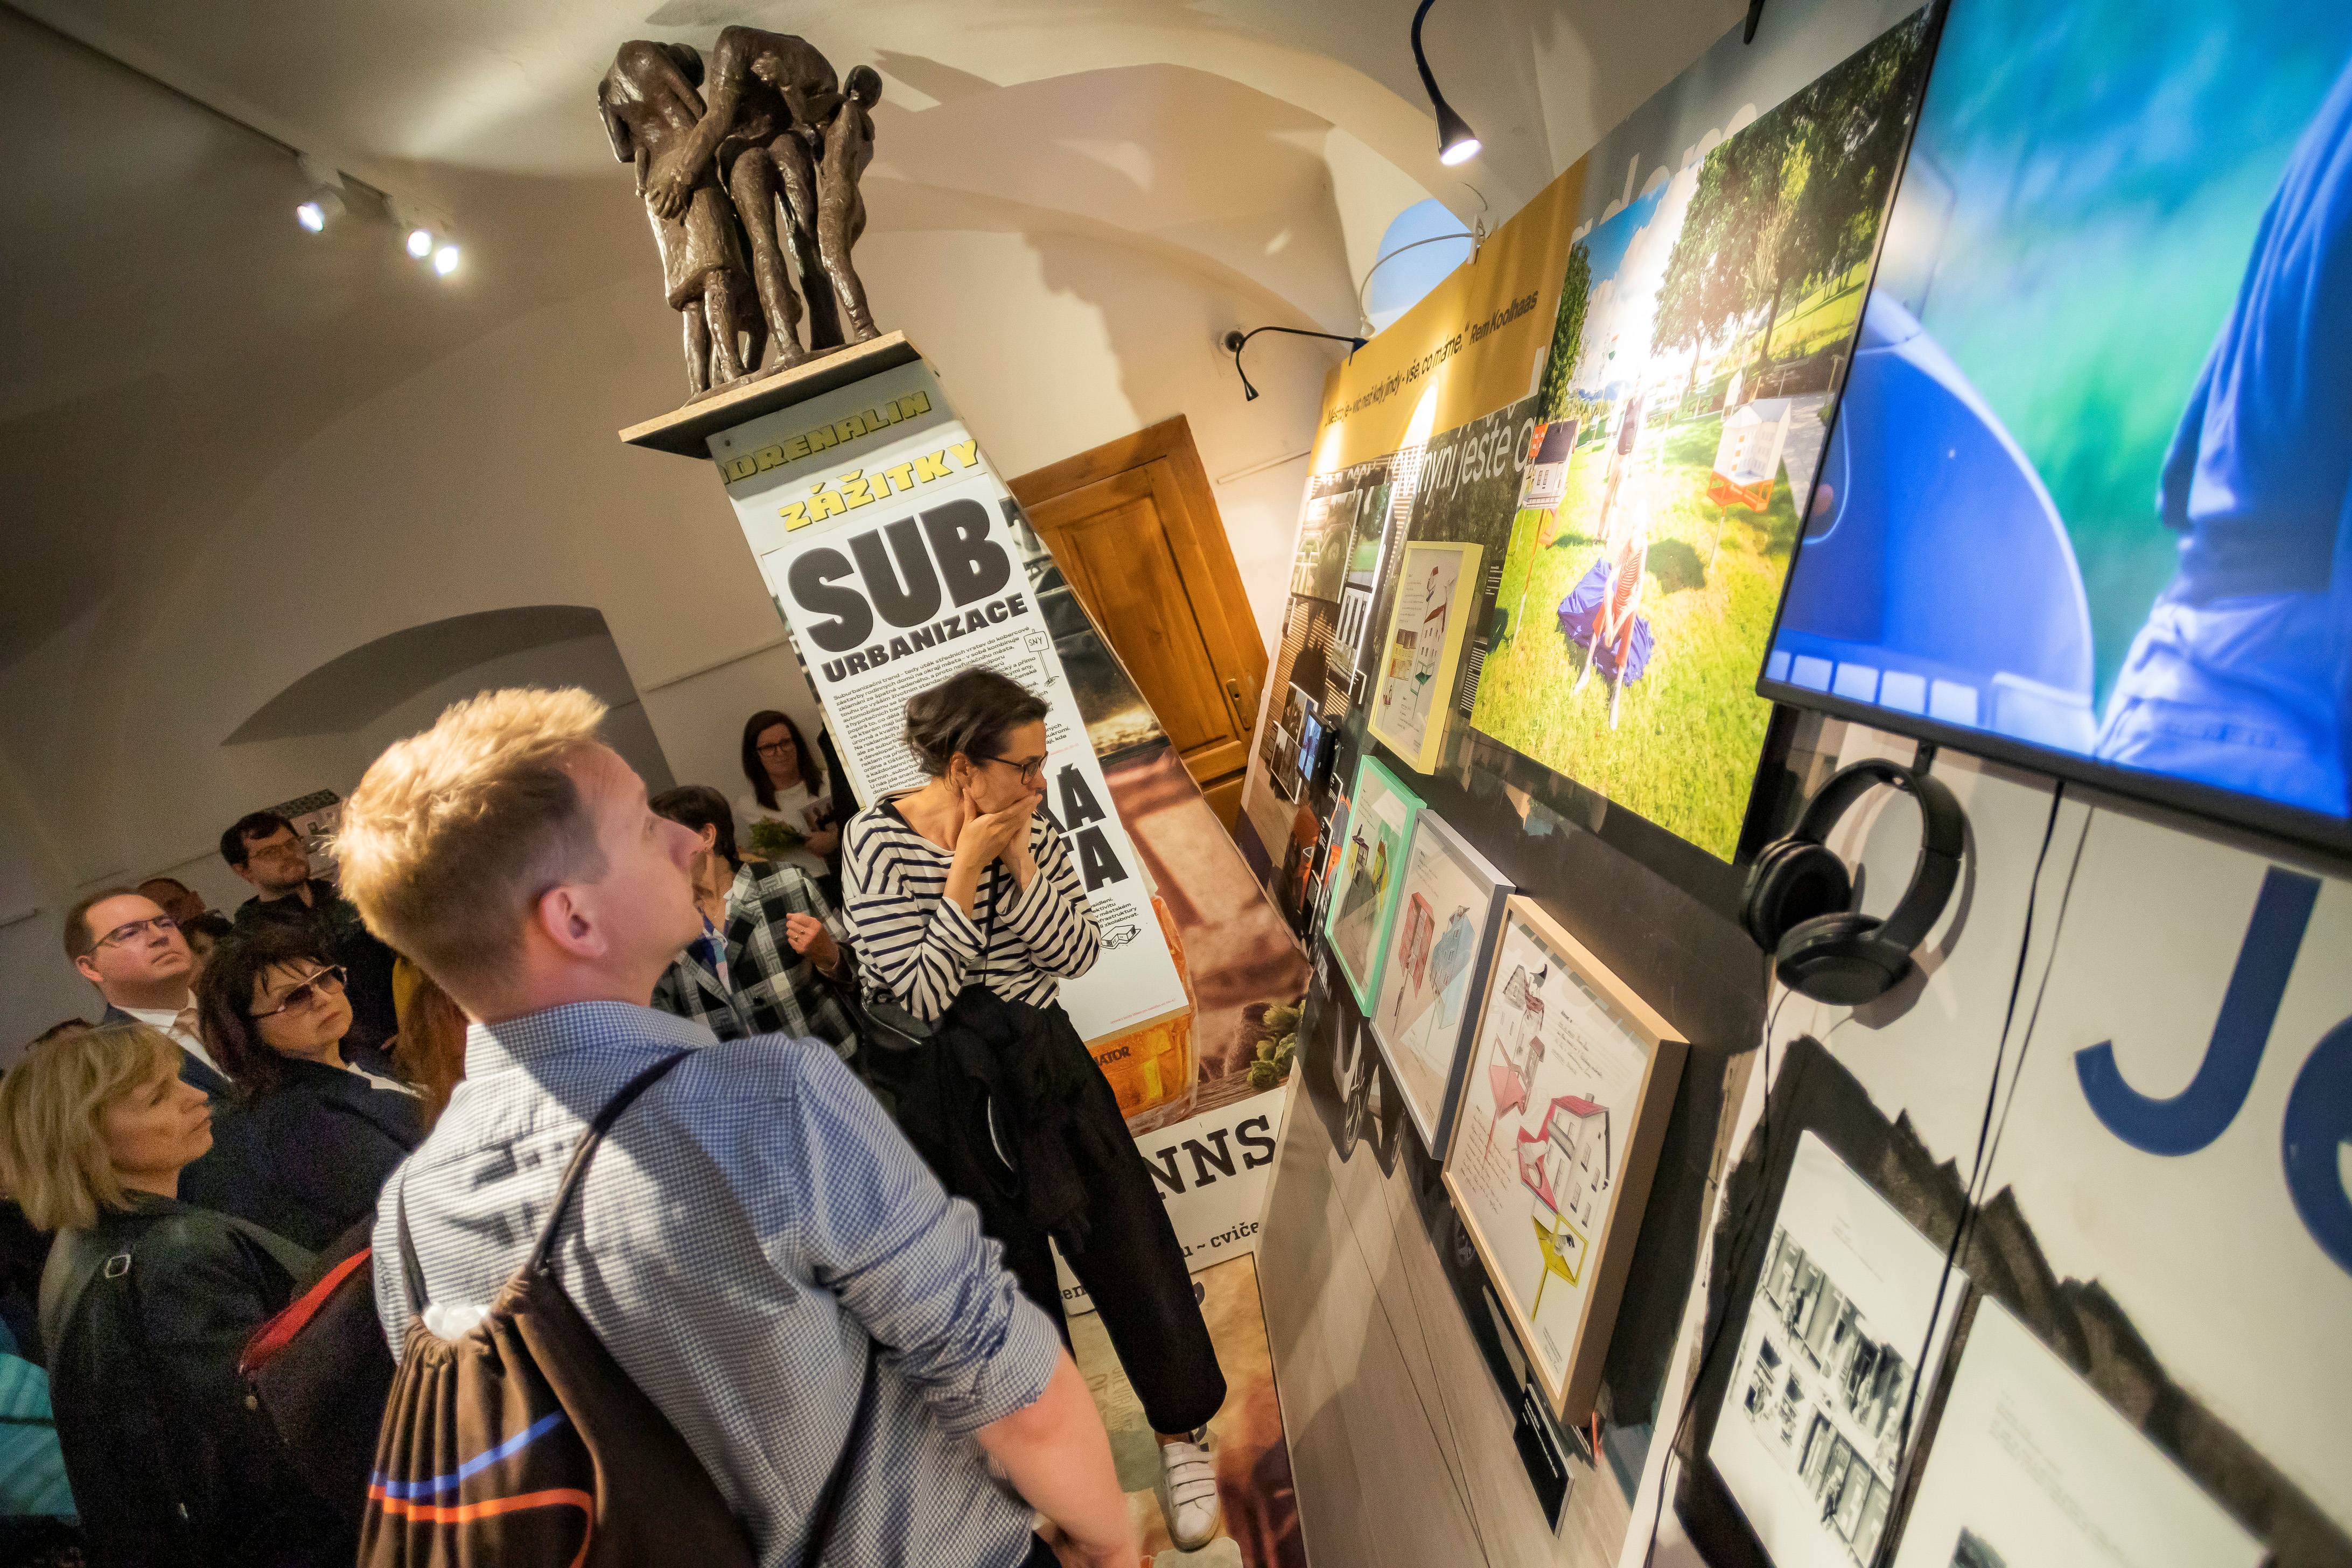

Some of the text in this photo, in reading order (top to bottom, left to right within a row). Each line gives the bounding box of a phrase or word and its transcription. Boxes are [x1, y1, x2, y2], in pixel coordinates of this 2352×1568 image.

[1422, 353, 1432, 375] co
[1469, 321, 1490, 345] Rem
[1489, 290, 1539, 333] Koolhaas
[777, 438, 978, 532] ZÁŽITKY
[787, 498, 1011, 653] SUB
[821, 592, 1028, 683] URBANIZACE
[1027, 635, 1044, 647] SNY
[833, 679, 881, 700] Suburbanizační
[882, 673, 900, 683] trend
[904, 667, 919, 675] tedy
[919, 660, 934, 669] útěk
[935, 649, 965, 663] středních
[966, 642, 986, 653] vrstev
[996, 626, 1030, 641] kobercové
[836, 693, 865, 706] zástavby
[864, 681, 895, 695] rodinných
[895, 674, 914, 684] domů
[923, 664, 941, 674] okraji
[941, 657, 961, 668] města
[970, 647, 986, 657] sobě
[986, 636, 1019, 651] kombinuje
[838, 698, 865, 711] zklamání
[874, 687, 897, 698] špatně
[897, 676, 930, 690] vedeného,
[935, 667, 953, 677] proto
[953, 653, 992, 670] nefunkčního
[840, 708, 859, 717] touhu
[869, 696, 890, 706] vyšším
[891, 686, 918, 698] životním
[982, 655, 1005, 666] odporu
[849, 709, 888, 726] hypotečních
[1017, 656, 1036, 667] přímo
[847, 723, 867, 734] popírá
[885, 711, 900, 719] dělá
[1005, 668, 1020, 676] kými
[857, 725, 880, 736] kterém
[881, 719, 894, 727] mají
[1013, 668, 1037, 680] čenské
[842, 703, 888, 723] automobilismu
[851, 733, 873, 745] úrovně
[878, 725, 900, 735] kvality
[1044, 725, 1070, 738] oukromí.
[1046, 722, 1062, 732] ných
[863, 732, 895, 747] reklamách
[1045, 733, 1067, 745] áji, kde
[863, 744, 898, 760] developeři.
[860, 757, 882, 767] reklam
[863, 763, 882, 772] online
[870, 759, 906, 776] každodenní
[867, 773, 888, 783] termín
[898, 770, 913, 779] snad
[872, 786, 888, 795] dobu
[1090, 896, 1114, 907] sídlení.
[1091, 901, 1116, 913] ektivitu
[1098, 902, 1132, 916] městském
[1103, 912, 1139, 927] zkolabovat.
[1142, 1115, 1276, 1200] NNS
